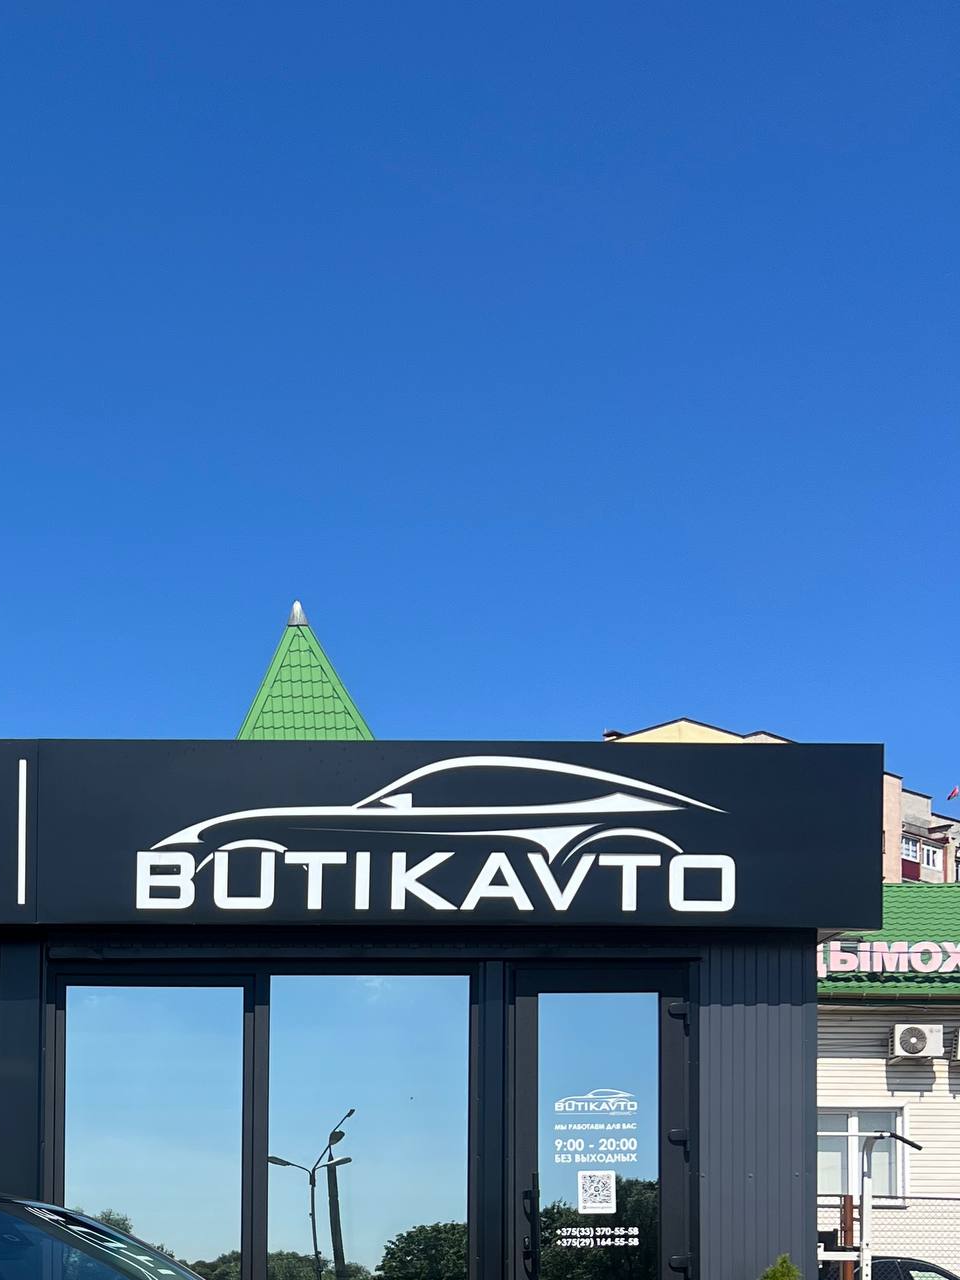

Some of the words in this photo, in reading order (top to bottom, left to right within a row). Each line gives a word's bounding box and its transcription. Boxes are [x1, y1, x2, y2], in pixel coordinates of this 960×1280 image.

[135, 850, 737, 913] BUTIKAVTO
[554, 1101, 638, 1111] BUTIKAVTO
[554, 1138, 585, 1151] 9:00
[598, 1138, 638, 1151] 20:00
[554, 1154, 572, 1163] БЕЗ
[575, 1153, 638, 1163] ВЫХОДНЫХ
[556, 1227, 594, 1237] +375(33)
[595, 1227, 639, 1236] 370-55-58
[556, 1238, 594, 1248] +375(29)
[596, 1238, 639, 1246] 164-55-58
